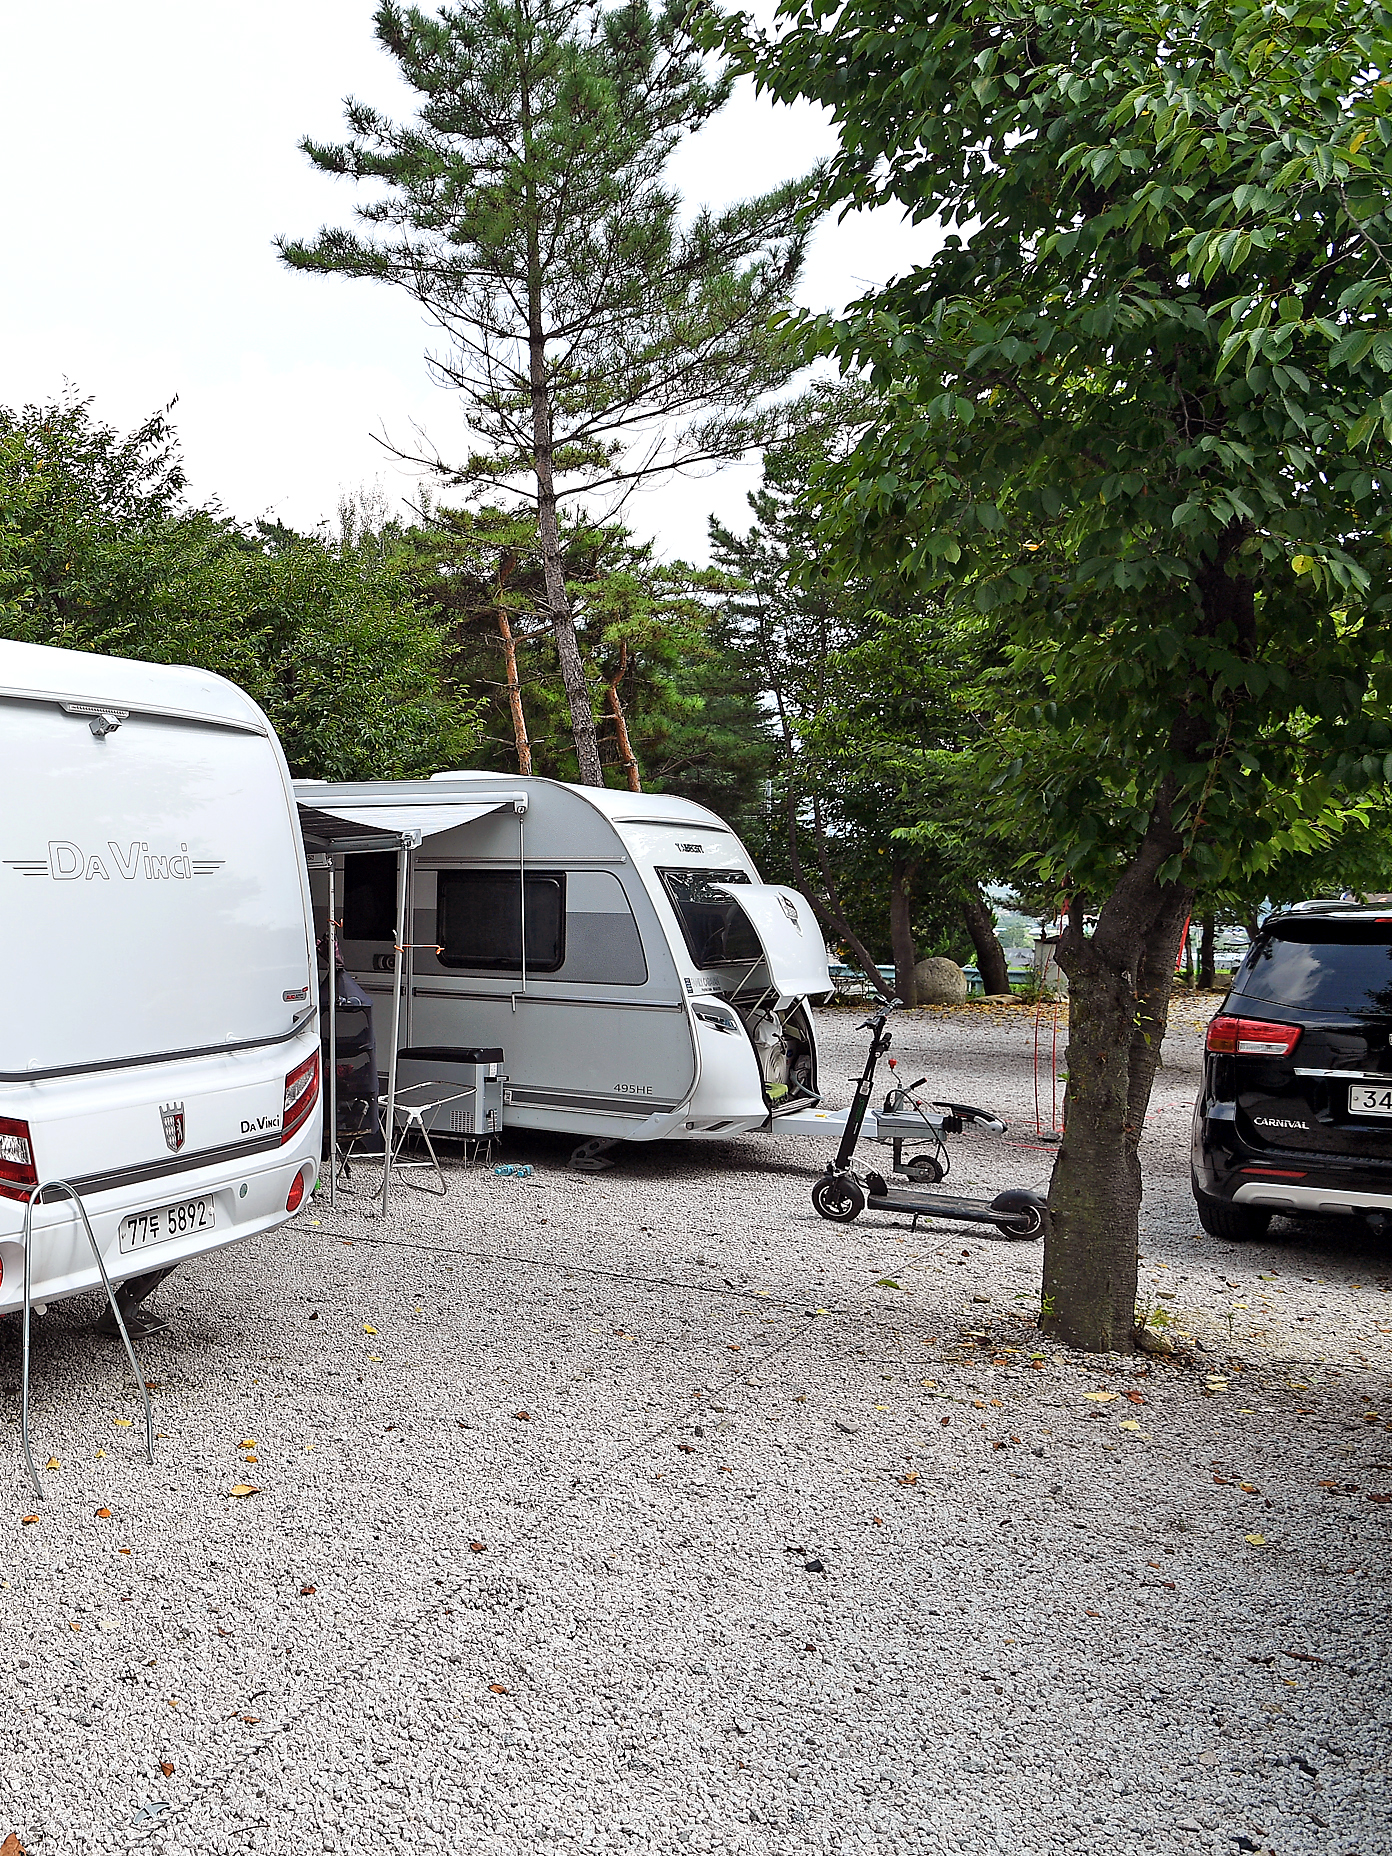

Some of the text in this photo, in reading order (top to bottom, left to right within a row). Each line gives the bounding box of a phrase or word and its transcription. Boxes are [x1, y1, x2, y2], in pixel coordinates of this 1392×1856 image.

[613, 1083, 653, 1095] 495HE
[1253, 1116, 1310, 1130] CARNIVAL
[127, 1200, 207, 1245] 77두 5892
